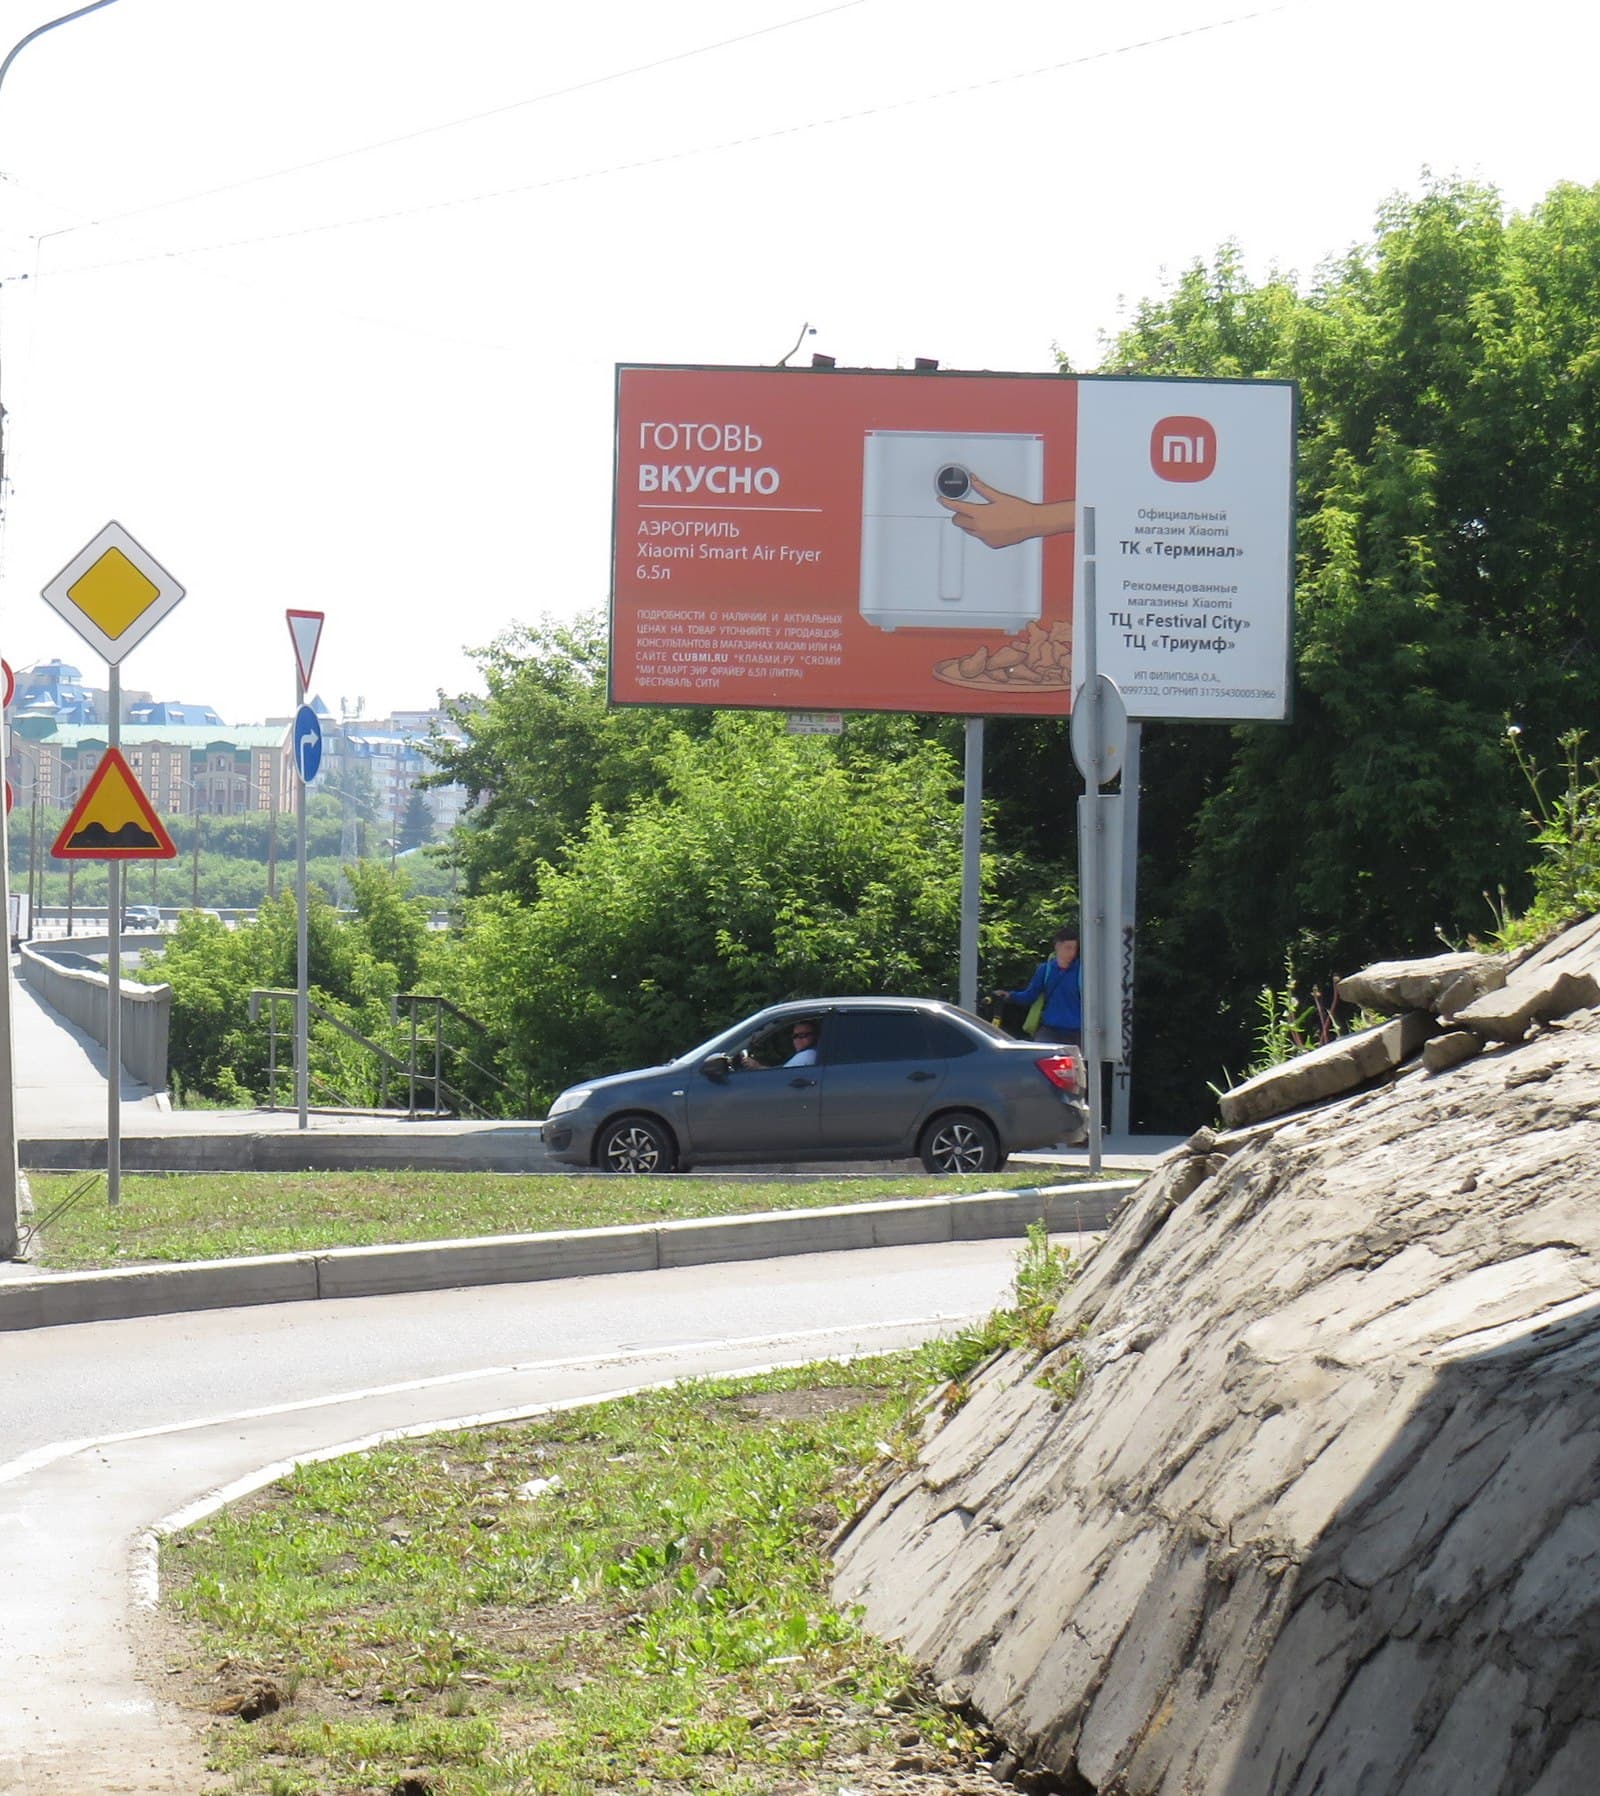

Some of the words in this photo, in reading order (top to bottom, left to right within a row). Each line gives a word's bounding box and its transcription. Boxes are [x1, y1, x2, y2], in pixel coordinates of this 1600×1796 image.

[640, 422, 763, 452] ГОТОВЬ
[638, 464, 780, 495] ВКУСНО
[1137, 508, 1228, 521] Официальный
[637, 520, 740, 538] АЭРОГРИЛЬ
[1134, 526, 1186, 536] магазин
[1188, 525, 1230, 537] Xiaomi
[637, 543, 695, 559] Xiaomi
[699, 543, 749, 561] Smart
[752, 545, 776, 561] Air
[779, 546, 822, 566] Fryer
[1119, 540, 1141, 555] ТК
[1145, 541, 1244, 559] «Терминал»
[636, 564, 671, 580] 6.5л
[1122, 580, 1238, 594] Рекомендованные
[1127, 597, 1188, 608] магазины
[1191, 597, 1233, 609] Xiaomi
[636, 609, 706, 620] ПОДРОБНОСТИ
[722, 611, 768, 622] НАЛИЧИИ
[771, 613, 779, 622] И
[783, 613, 842, 625] АКТУАЛЬНЫХ
[1109, 612, 1133, 629] ТЦ
[1136, 613, 1207, 629] «Festival
[1210, 614, 1251, 633] City»
[636, 624, 667, 634] ЦЕНАХ
[670, 625, 683, 634] НА
[688, 625, 717, 635] ТОВАР
[636, 638, 711, 649] КОНСУЛЬТАНТОВ
[720, 639, 774, 650] МАГАЗИНАХ
[808, 642, 828, 652] ИЛИ
[829, 643, 842, 652] НА
[1122, 634, 1147, 651] ТЦ
[1151, 635, 1235, 654] «Триумф»
[671, 652, 729, 663] CLUBMI.RU
[656, 665, 688, 675] СМАРТ
[1148, 671, 1200, 682] ФИЛИПОВА
[695, 678, 720, 689] СИТИ
